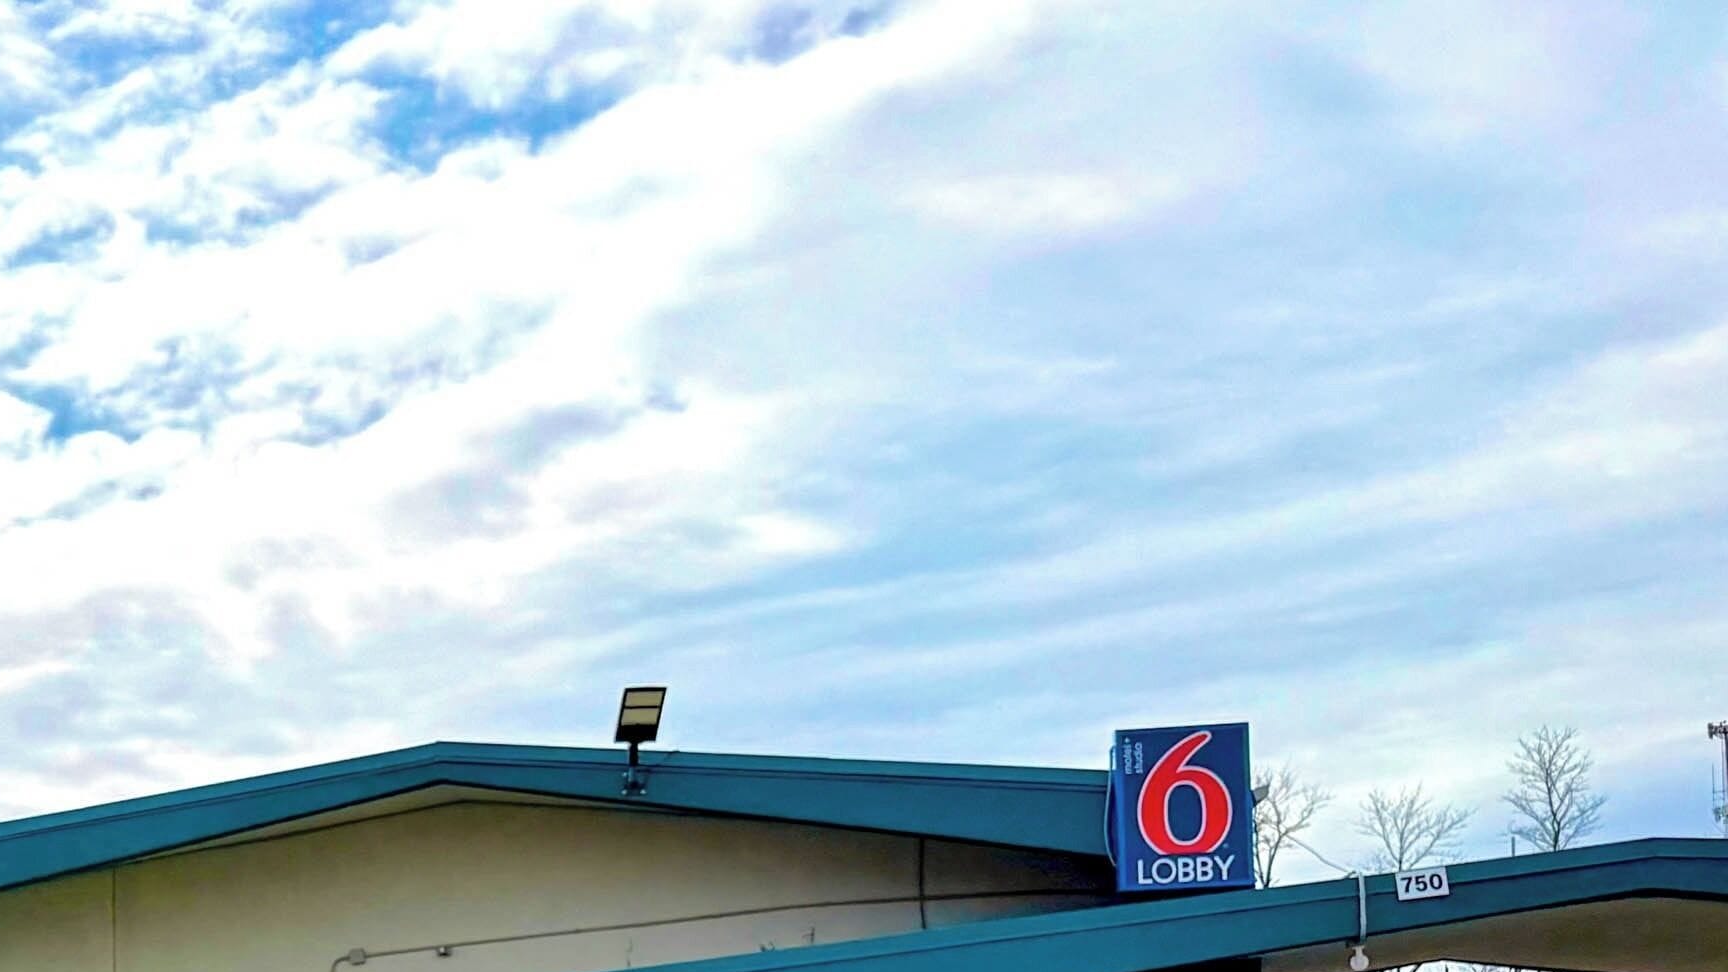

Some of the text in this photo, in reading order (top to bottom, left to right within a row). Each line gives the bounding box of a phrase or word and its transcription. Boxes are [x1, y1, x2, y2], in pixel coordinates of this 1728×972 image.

[1136, 730, 1233, 855] 6
[1137, 855, 1235, 884] LOBBY
[1400, 873, 1443, 893] 750
